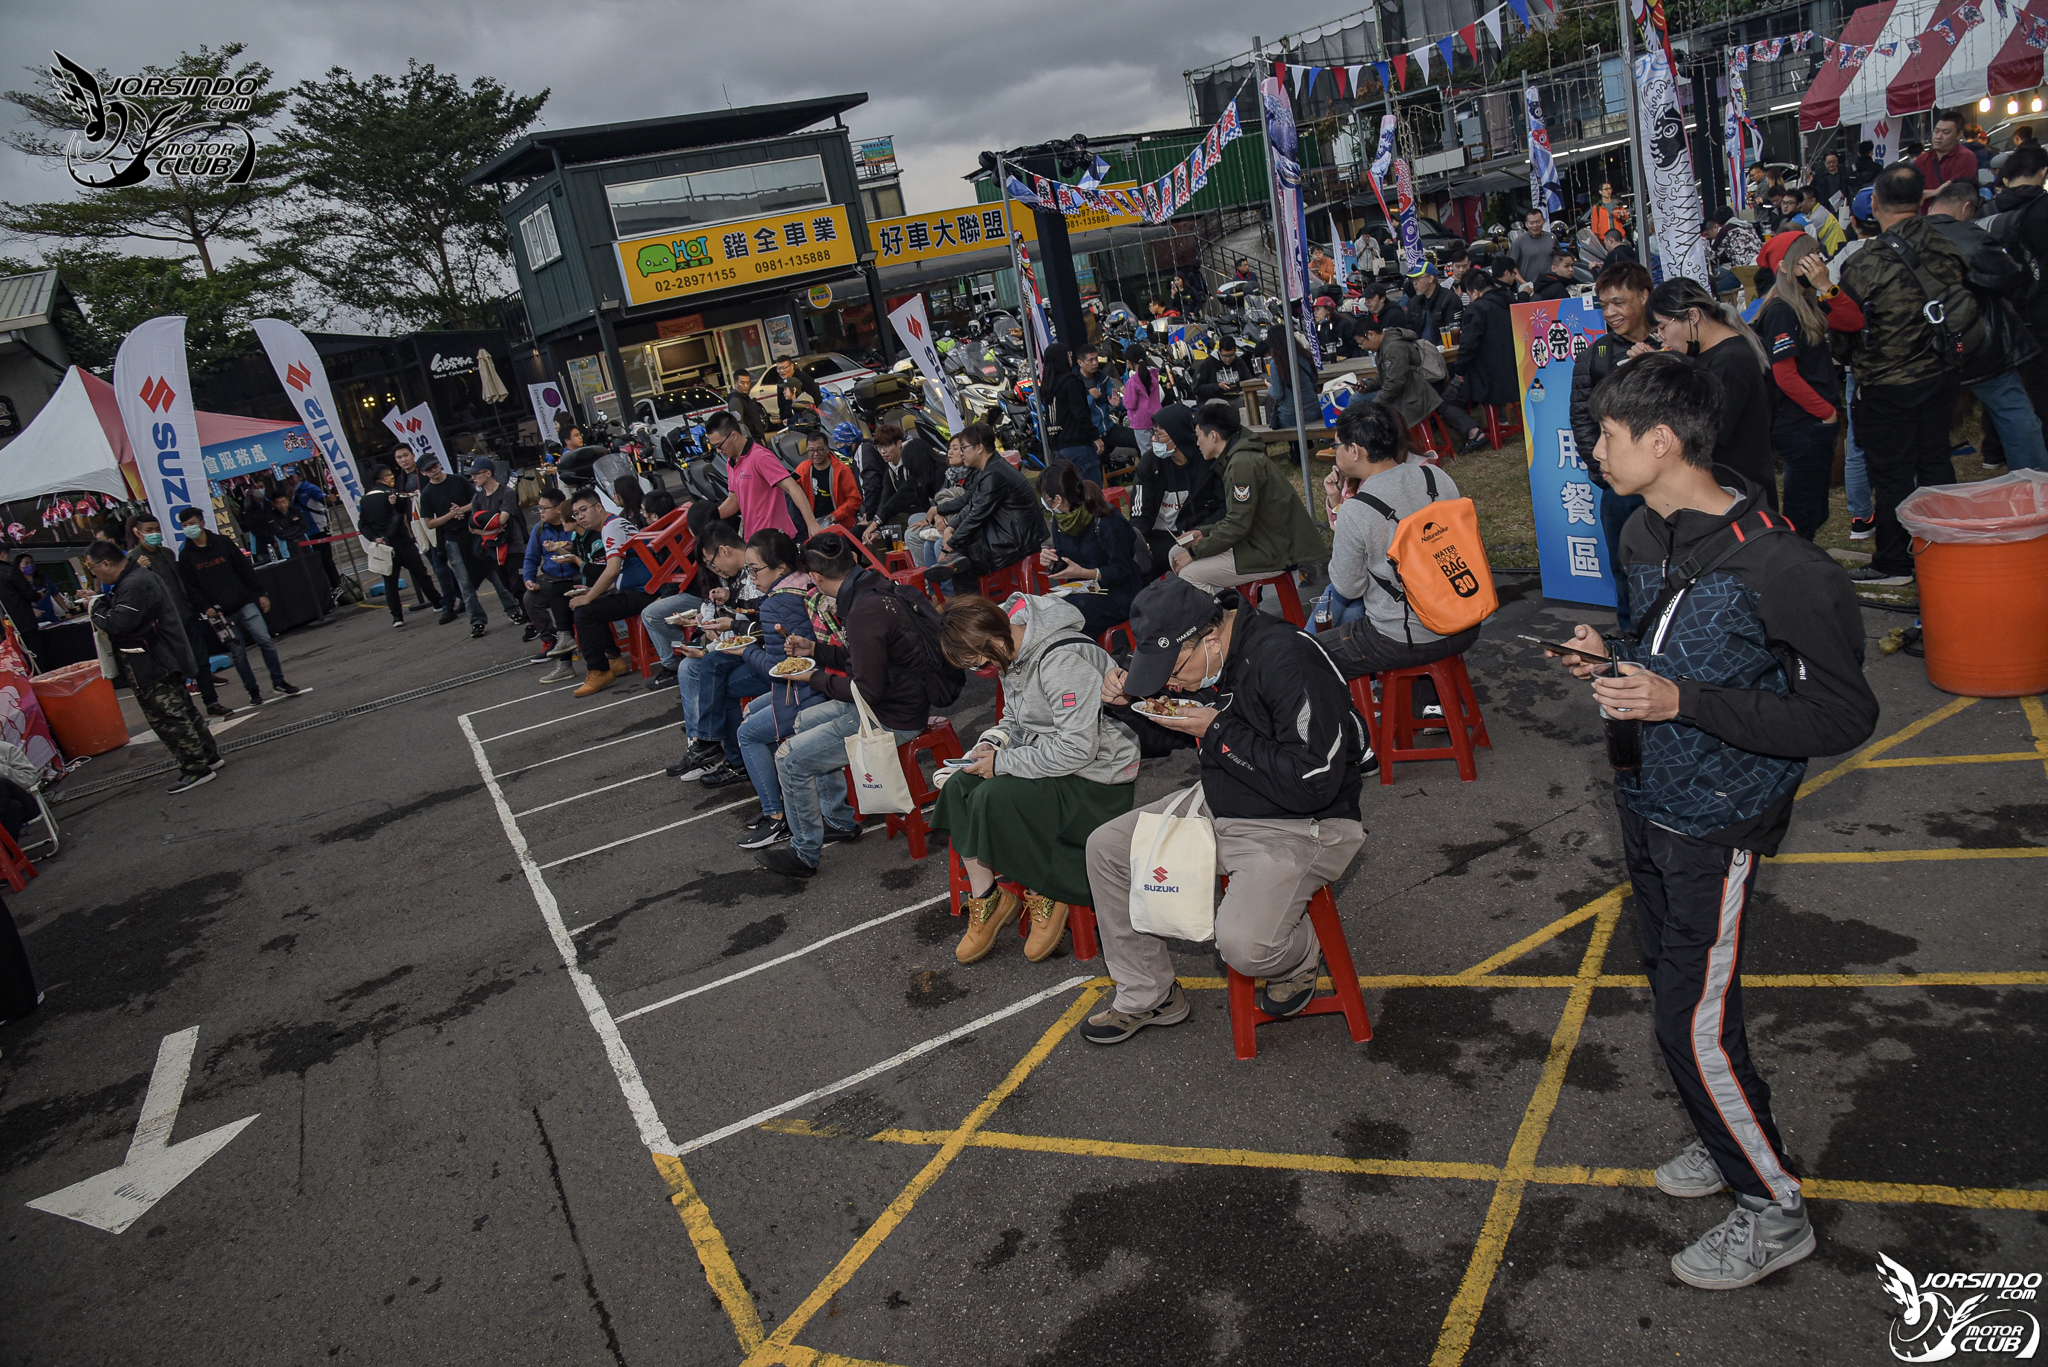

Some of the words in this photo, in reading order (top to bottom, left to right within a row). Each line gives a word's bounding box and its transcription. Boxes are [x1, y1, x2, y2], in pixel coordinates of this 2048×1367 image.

[1066, 214, 1110, 229] 981-135888
[879, 209, 1006, 258] 好車大聯盟
[672, 236, 708, 260] HOT
[755, 249, 832, 274] 0981-135888
[655, 267, 737, 293] 02-28971155
[202, 444, 268, 475] 會服務處
[152, 422, 192, 555] SUZU
[1556, 428, 1602, 578] 用餐區
[1421, 526, 1449, 543] Naturehike
[1433, 545, 1457, 560] WATER
[1436, 552, 1459, 566] PROOF
[1441, 556, 1468, 577] BAG
[1454, 574, 1476, 593] 30
[1144, 884, 1179, 893] SUZUKI
